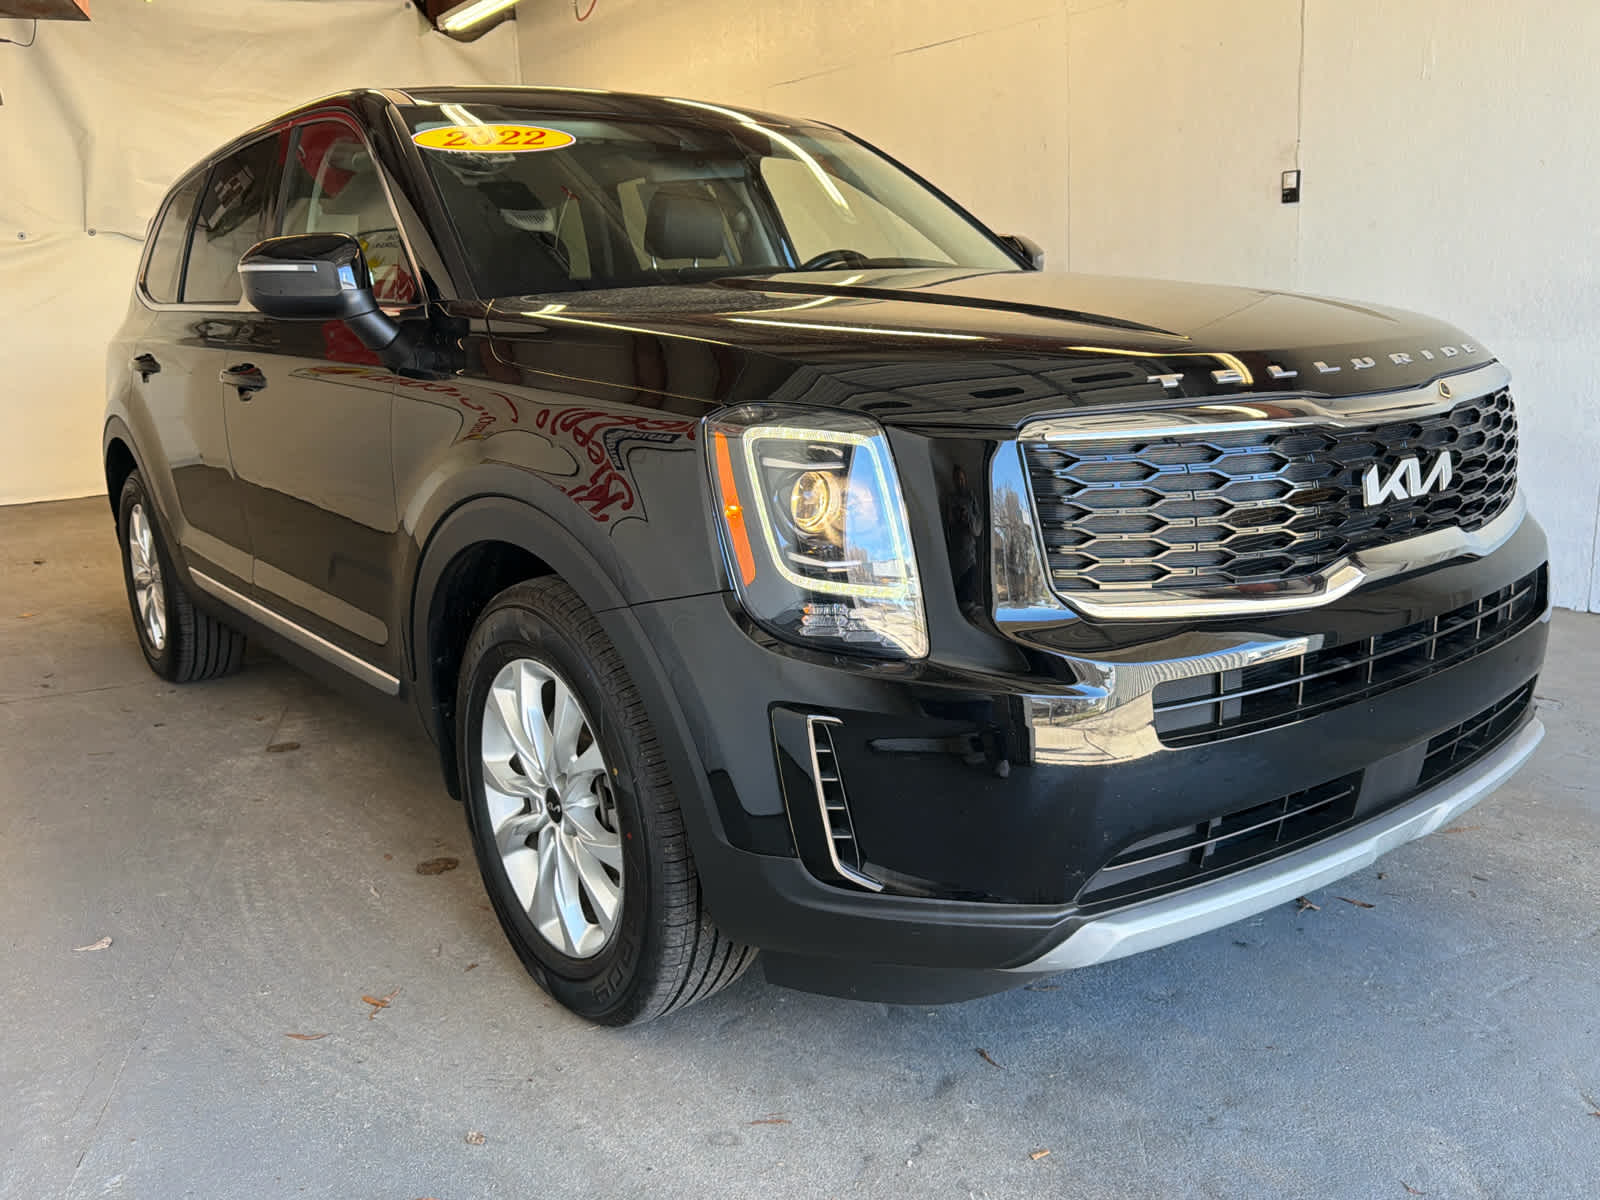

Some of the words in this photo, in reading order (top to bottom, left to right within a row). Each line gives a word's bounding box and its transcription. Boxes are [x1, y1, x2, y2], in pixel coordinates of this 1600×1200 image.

[443, 130, 546, 146] 2022
[1146, 343, 1478, 388] TELLURIDE
[1362, 450, 1452, 507] KIA
